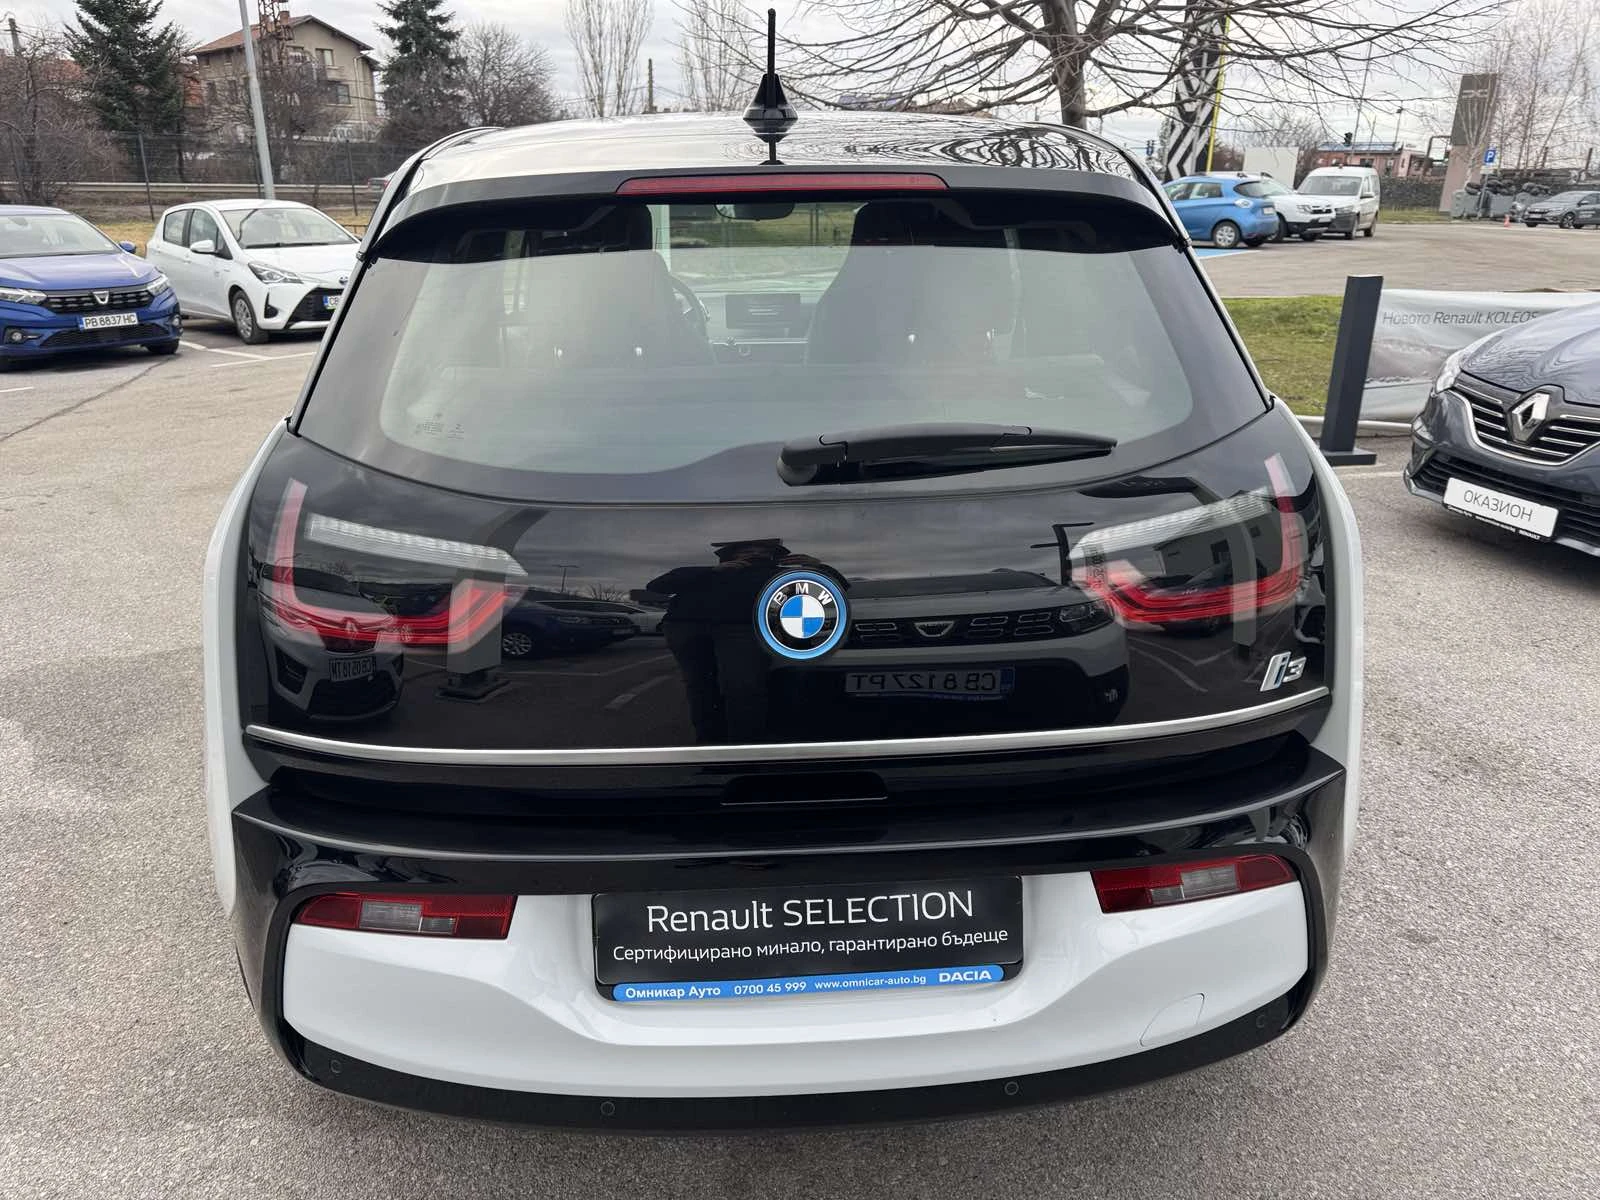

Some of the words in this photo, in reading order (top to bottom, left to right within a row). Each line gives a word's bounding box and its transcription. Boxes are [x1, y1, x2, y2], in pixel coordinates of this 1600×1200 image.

[1487, 151, 1494, 162] P
[1383, 311, 1431, 325] Новото
[1433, 311, 1483, 325] Renault
[1463, 489, 1534, 522] ОКАЗИОН
[773, 582, 833, 606] BMW
[1260, 651, 1307, 691] i3
[647, 900, 774, 933] Renault
[783, 890, 974, 927] SELECTION
[613, 945, 752, 964] Сертифицирано
[756, 939, 825, 957] минало,
[829, 931, 938, 954] гарантирано
[941, 929, 1009, 947] бъдеще
[625, 985, 685, 999] Омникар
[688, 983, 721, 998] Ауто
[734, 984, 764, 996] 0700
[767, 982, 782, 993] 45
[784, 980, 807, 992] 999
[814, 973, 927, 990] www.omnicar-auto.bg
[938, 969, 992, 984] DACIA
